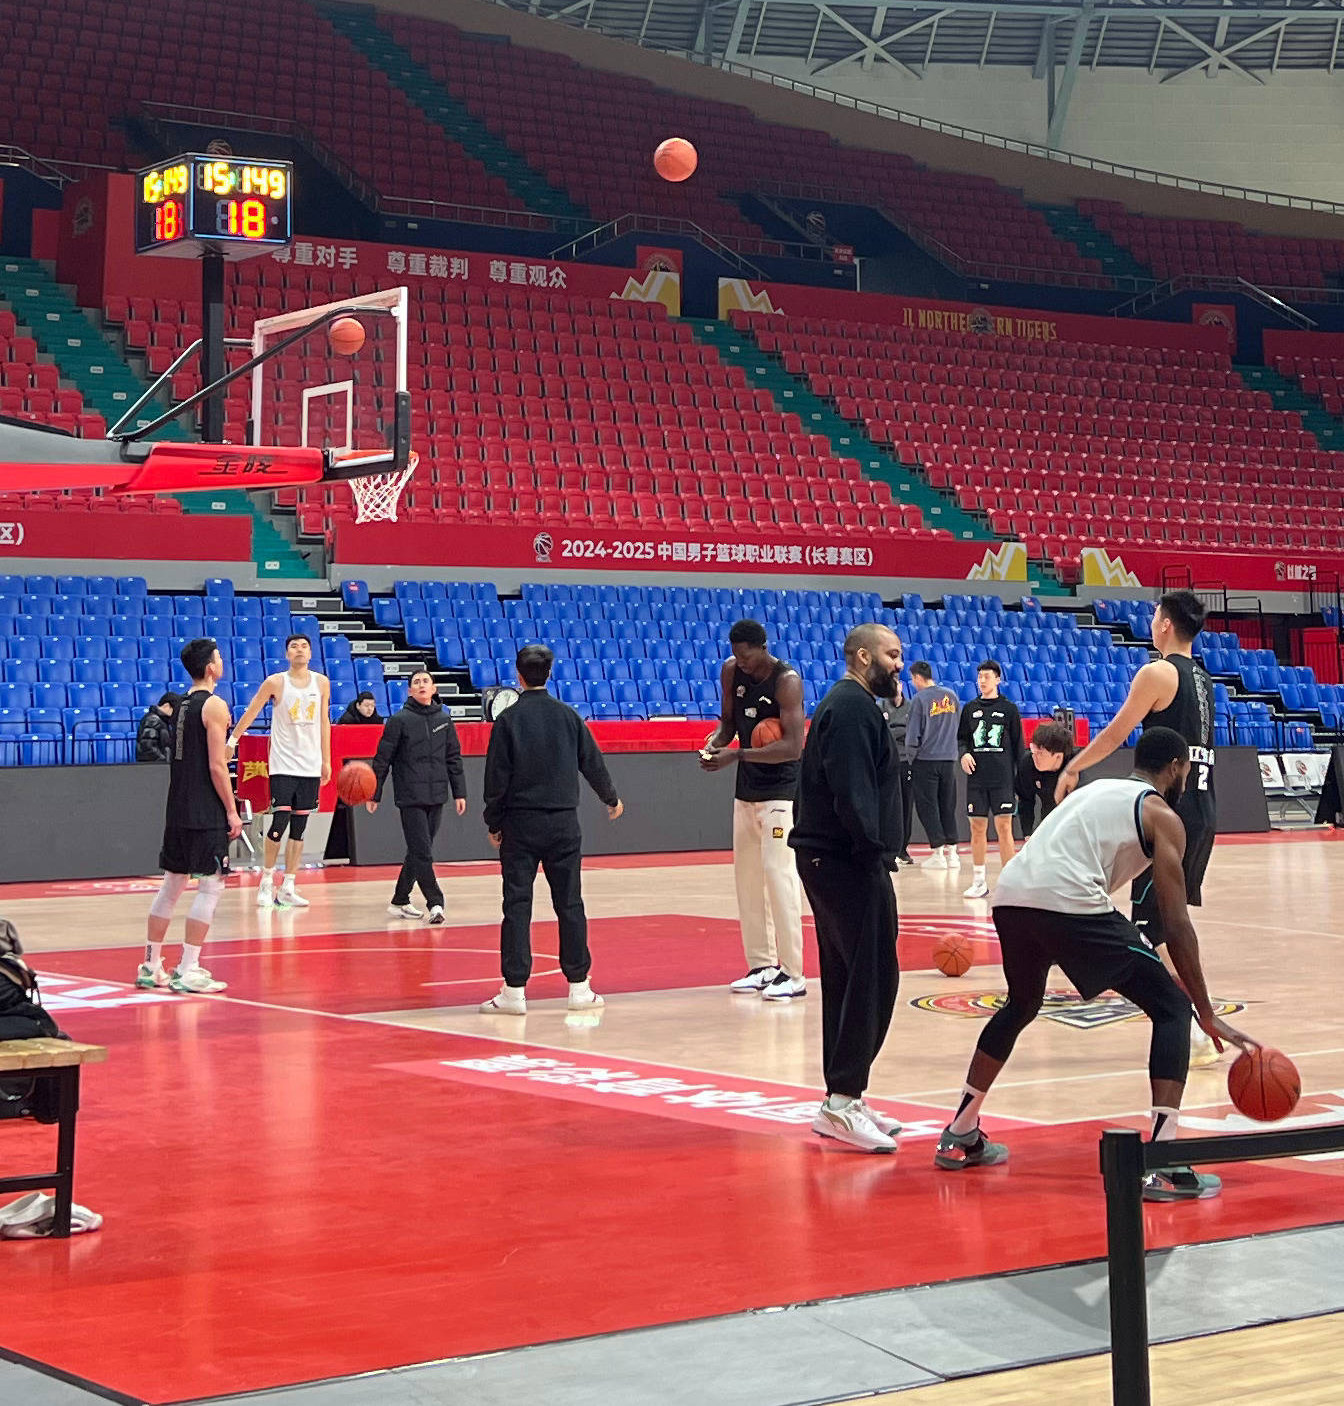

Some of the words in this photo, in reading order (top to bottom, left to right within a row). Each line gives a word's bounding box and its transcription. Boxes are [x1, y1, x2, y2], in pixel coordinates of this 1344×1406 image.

[227, 197, 267, 240] 18
[272, 242, 359, 269] 尊重对手
[387, 250, 469, 281] 尊重裁判
[489, 259, 568, 289] 尊重观众
